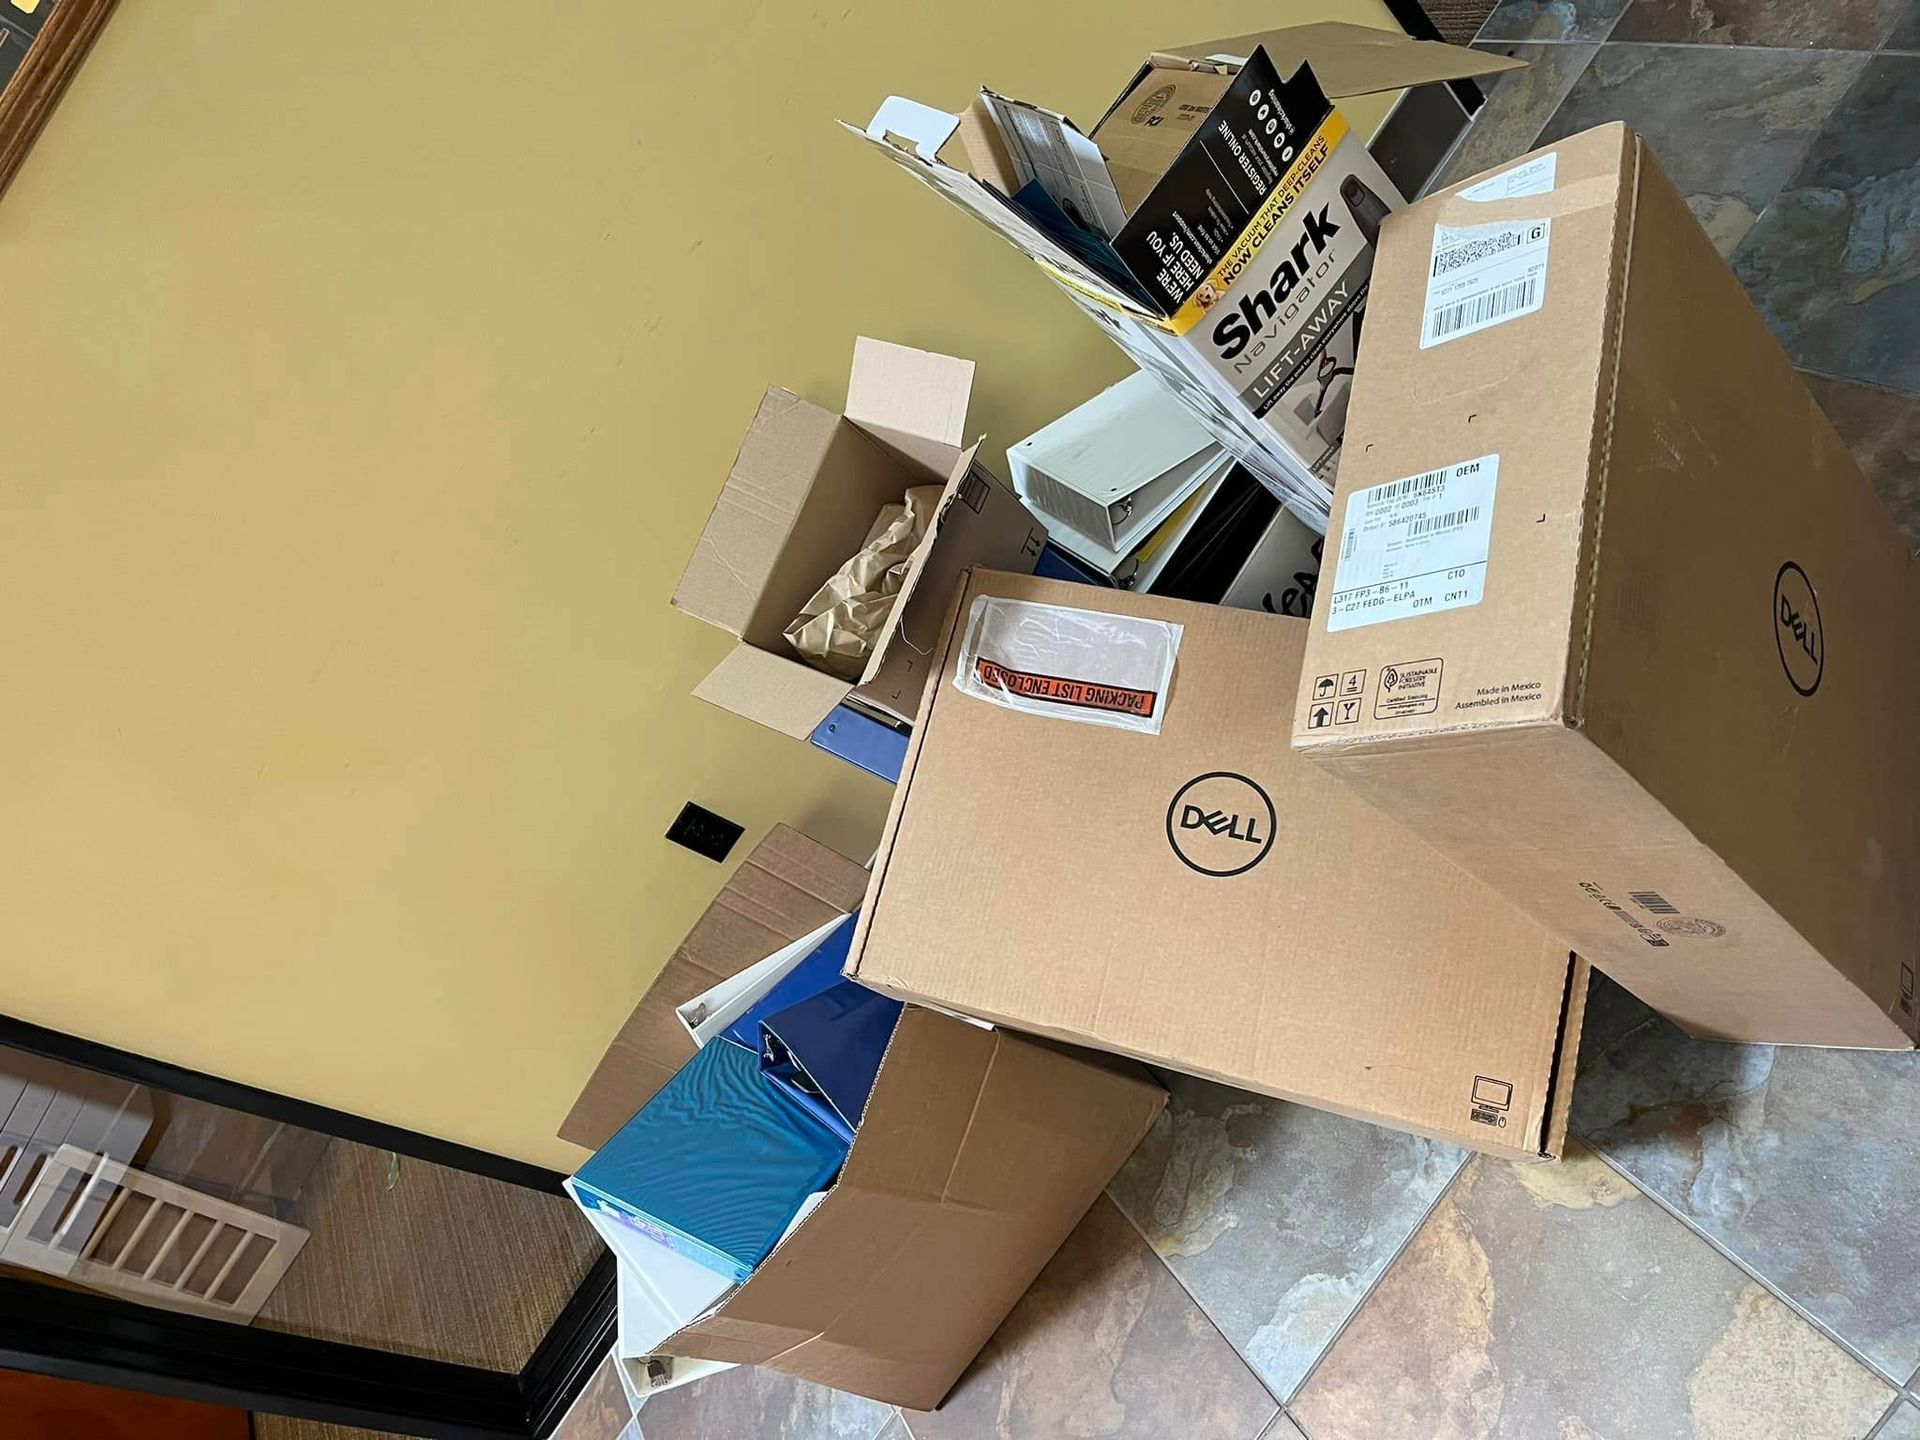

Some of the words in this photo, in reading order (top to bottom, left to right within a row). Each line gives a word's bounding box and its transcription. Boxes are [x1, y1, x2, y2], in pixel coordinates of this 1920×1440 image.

[1218, 120, 1242, 156] ONLINE
[1238, 152, 1267, 196] REGISTER
[1217, 258, 1234, 277] THE
[1232, 221, 1262, 258] VACUUM
[1260, 197, 1279, 222] THAT
[1277, 135, 1326, 198] DEEP-CLEANS
[1223, 247, 1252, 286] NOW
[1252, 192, 1295, 248] CLEANS
[1292, 143, 1329, 194] ITSELF
[1146, 231, 1167, 257] YOU
[1169, 232, 1184, 254] US.
[1531, 227, 1541, 240] G
[1162, 254, 1175, 267] IF
[1180, 250, 1204, 280] NEED
[1156, 268, 1184, 304] WE'RE
[1170, 261, 1195, 292] HERE
[1212, 202, 1342, 361] Shark
[1233, 250, 1337, 374] Navigator
[1253, 280, 1349, 399] LIFT-AWAY
[1263, 399, 1273, 410] Lift
[1272, 387, 1286, 400] away
[1285, 377, 1294, 388] the
[1303, 357, 1311, 366] to
[1309, 344, 1323, 360] clean
[1322, 312, 1348, 346] everywhere
[1346, 294, 1361, 313] above
[1456, 463, 1480, 478] OEM
[1447, 568, 1465, 581] CTO
[1334, 593, 1352, 605] L317
[1444, 589, 1468, 602] CNT1
[1780, 593, 1818, 666] DELL
[982, 664, 1049, 695] ENCLOSED
[1050, 681, 1082, 701] LIST
[1476, 686, 1499, 696] Made
[1500, 685, 1510, 694] in
[1511, 681, 1542, 692] Mexico
[1085, 687, 1144, 710] PACKING
[1455, 696, 1499, 710] Assembled
[1500, 696, 1510, 705] in
[1510, 692, 1542, 703] Mexico
[1180, 804, 1262, 844] DELL
